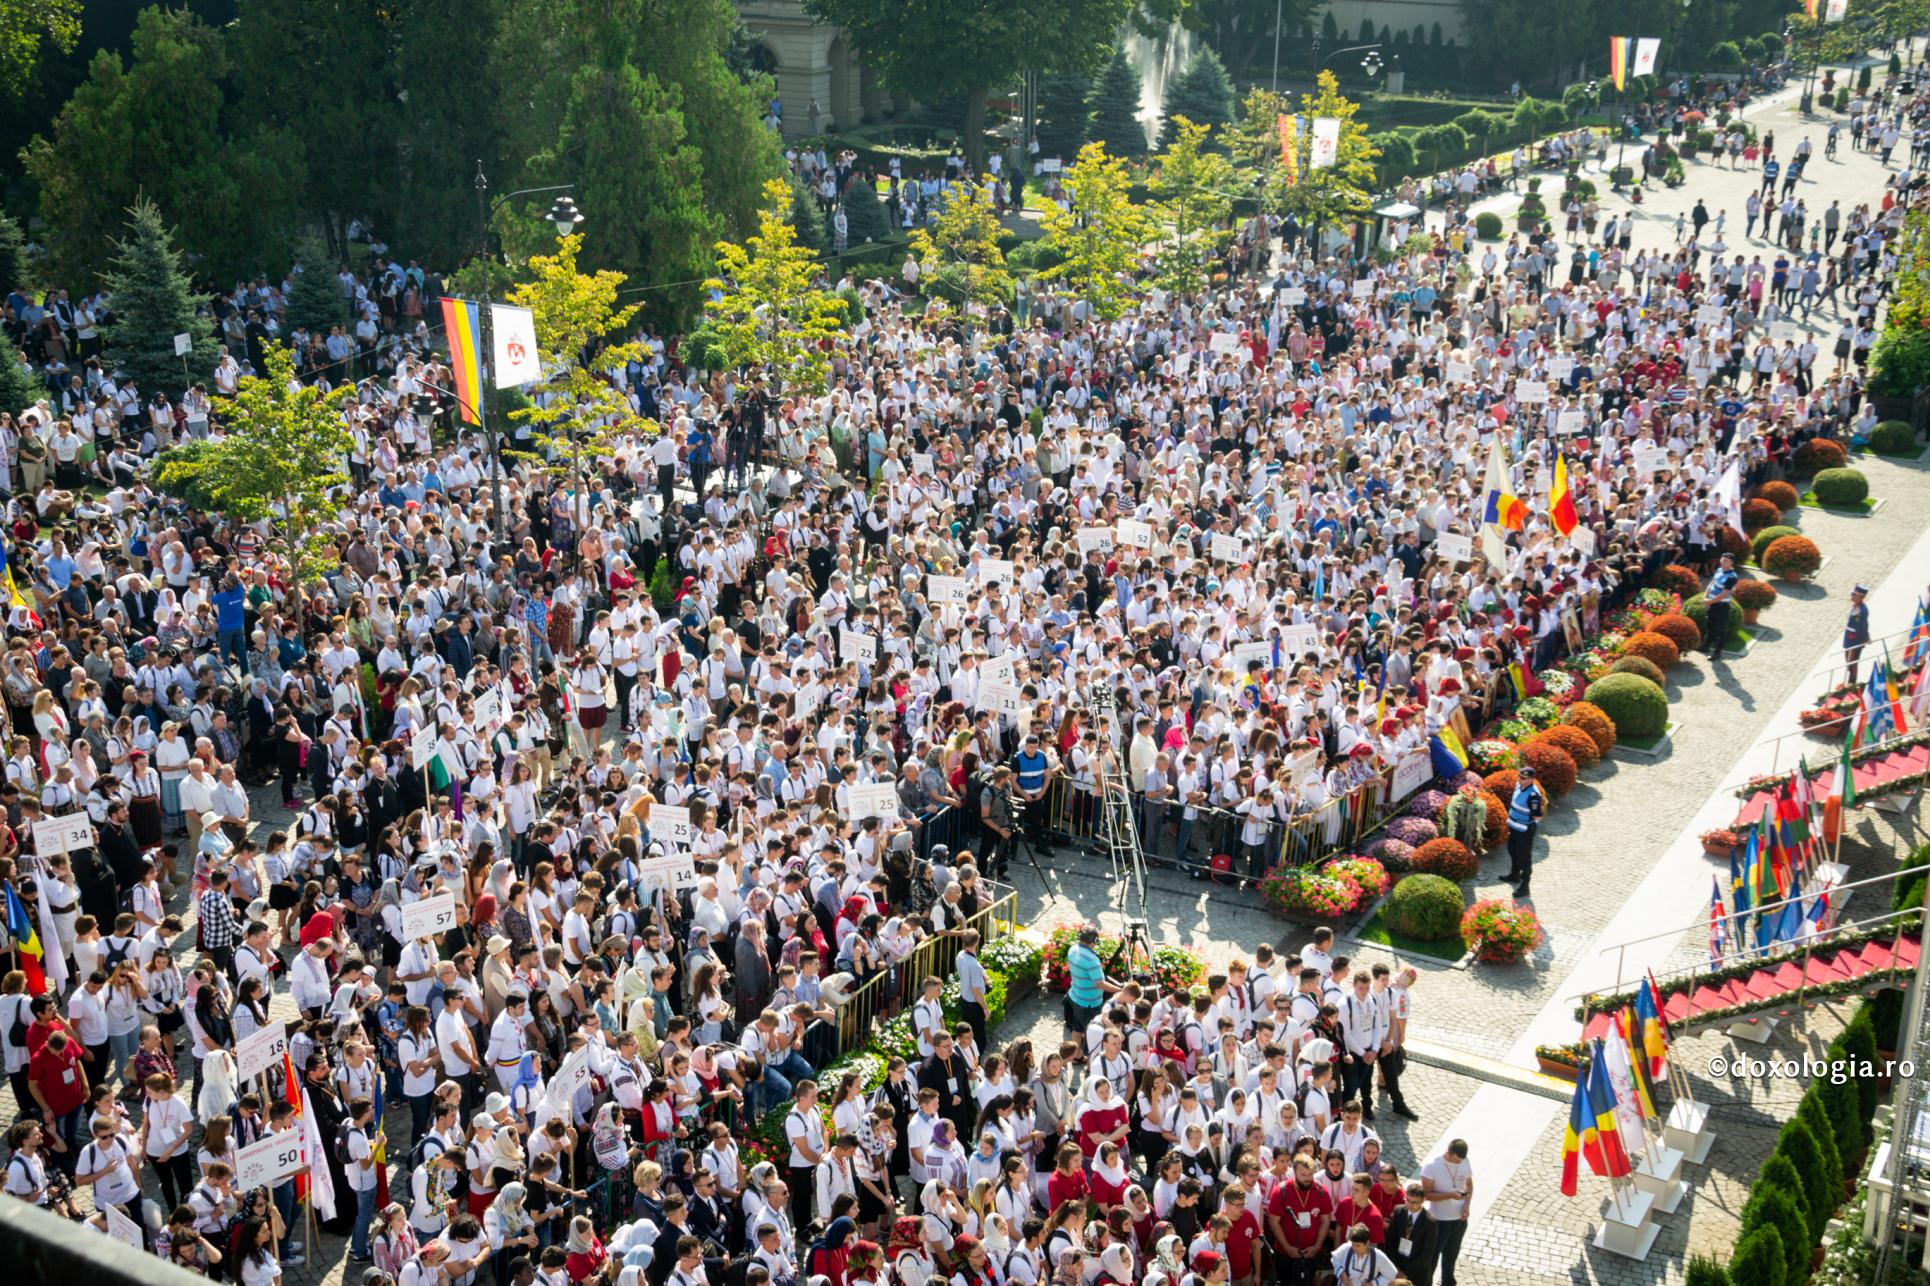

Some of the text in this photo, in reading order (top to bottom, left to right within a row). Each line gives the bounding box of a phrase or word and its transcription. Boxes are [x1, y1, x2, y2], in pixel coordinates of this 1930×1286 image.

[1099, 539, 1111, 548] 26
[1137, 533, 1148, 544] 52
[1231, 549, 1240, 559] 33
[1000, 573, 1011, 583] 26
[952, 589, 964, 598] 26
[1305, 636, 1316, 646] 43
[861, 648, 872, 659] 22
[998, 668, 1009, 679] 22
[1004, 699, 1016, 710] 11
[879, 799, 894, 810] 25
[674, 824, 687, 836] 25
[71, 829, 88, 843] 34
[676, 869, 692, 882] 14
[436, 911, 452, 925] 57
[270, 1039, 284, 1056] 18
[575, 1065, 586, 1083] 55
[278, 1149, 298, 1167] 50
